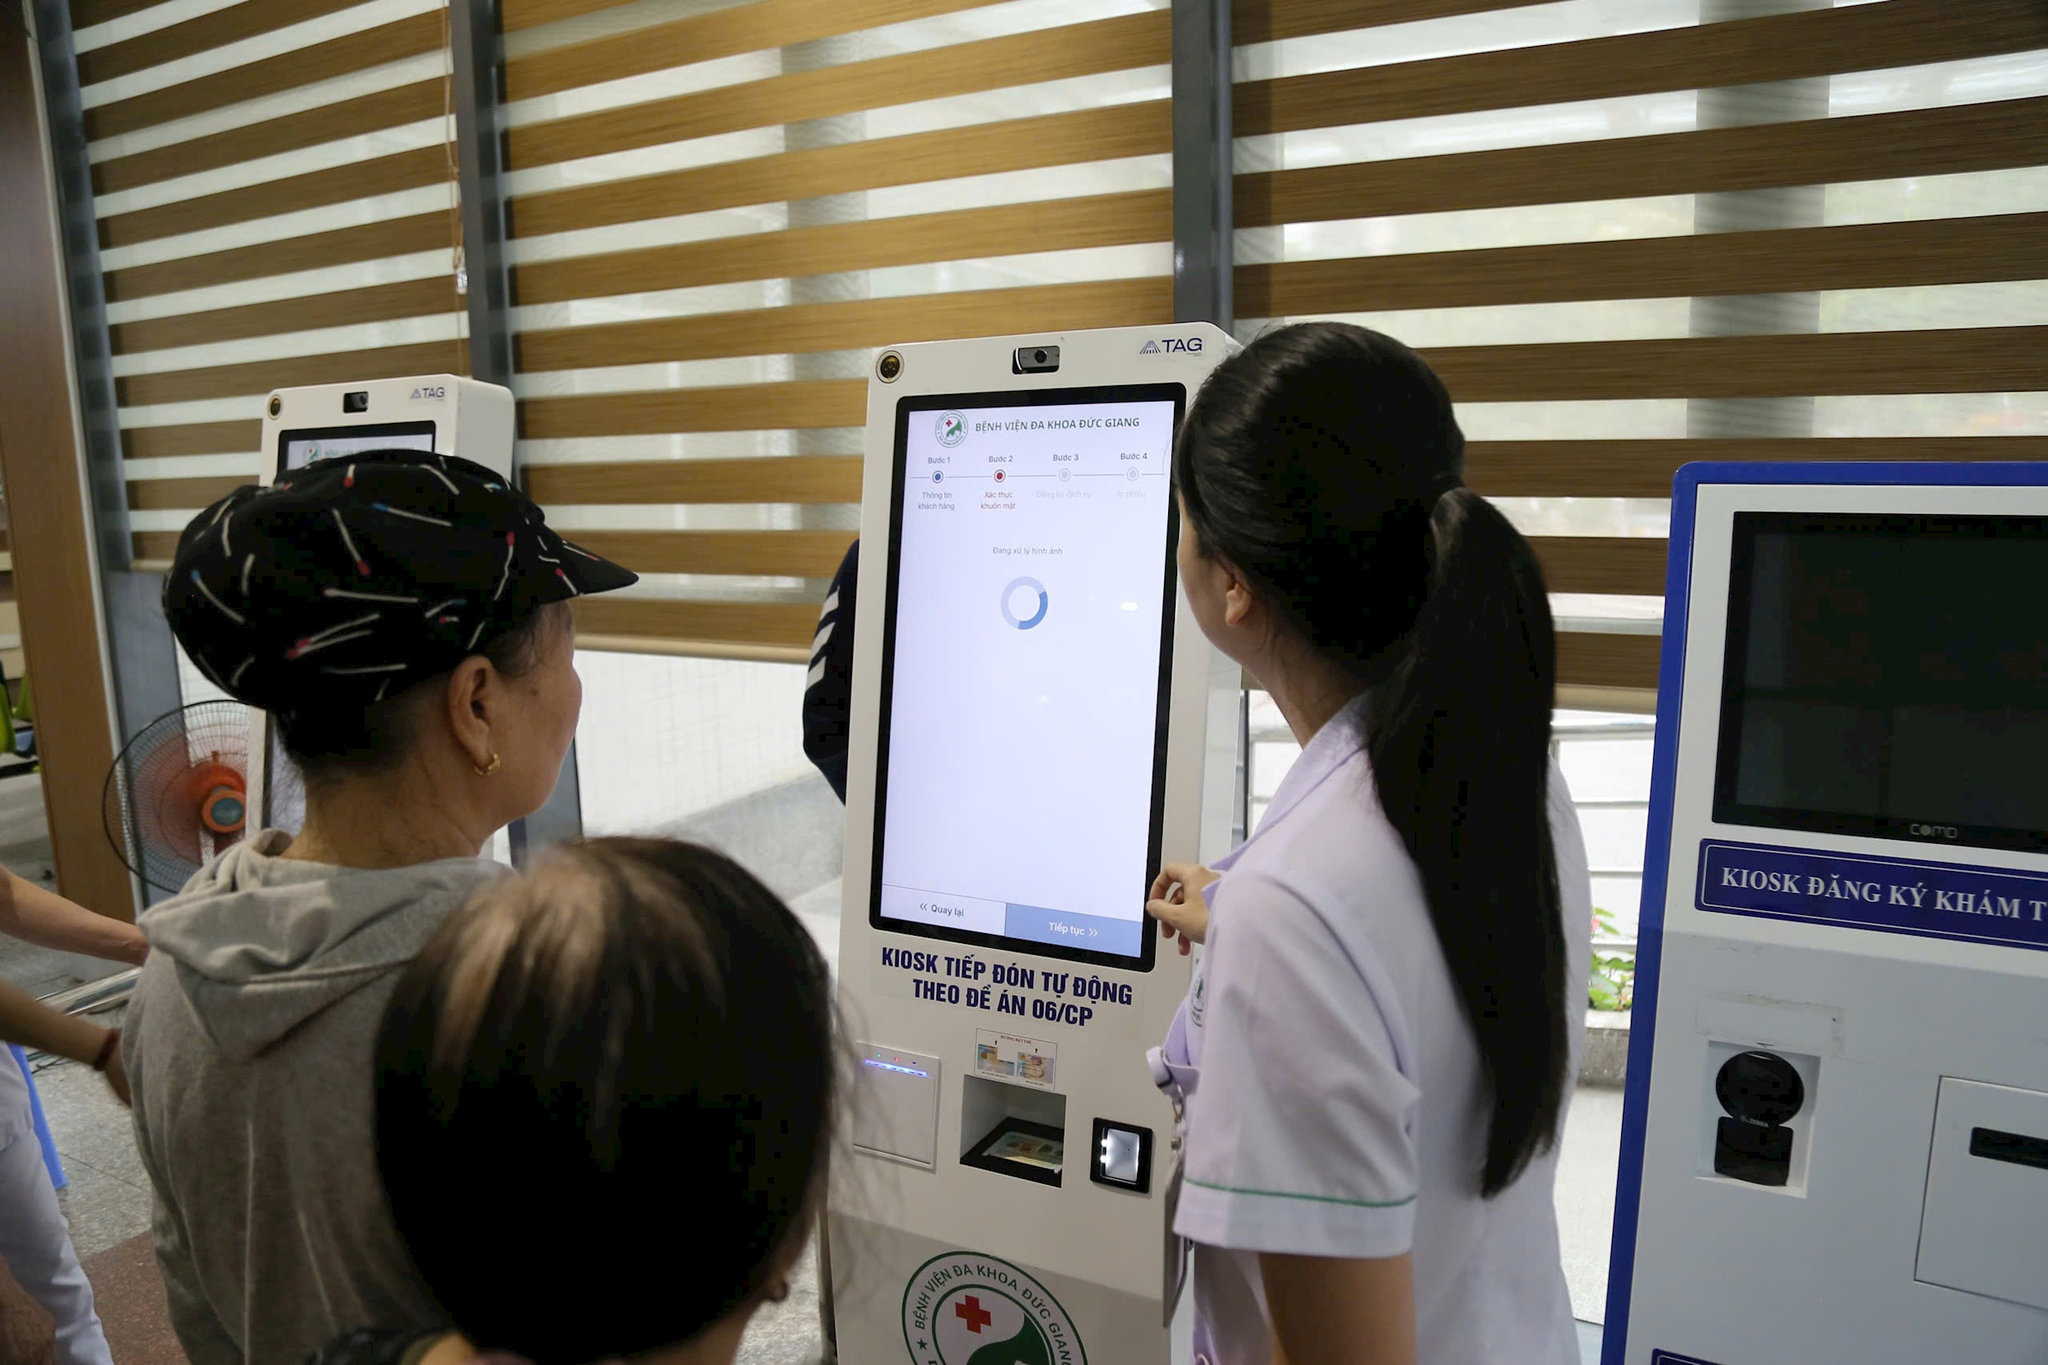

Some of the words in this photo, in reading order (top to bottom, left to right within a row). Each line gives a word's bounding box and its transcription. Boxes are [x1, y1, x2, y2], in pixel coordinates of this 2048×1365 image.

[1162, 338, 1202, 352] TAG
[422, 386, 445, 398] TAG
[976, 421, 1001, 434] BỆNH
[1005, 419, 1027, 433] VIỆN
[1031, 420, 1044, 430] ĐA
[1048, 419, 1076, 430] KHOA
[1079, 416, 1102, 428] ĐỨC
[1105, 417, 1140, 428] GIANG
[1009, 455, 1014, 463] 2
[1074, 453, 1079, 461] 3
[1142, 452, 1148, 460] 4
[1721, 867, 1801, 894] KIOSK
[1807, 873, 1881, 903] ĐĂNG
[1888, 882, 1928, 908] KÝ
[1934, 889, 2021, 919] KHÁM
[931, 904, 952, 916] Quay
[955, 907, 965, 917] lại
[1049, 921, 1068, 934] Tiếp
[1069, 925, 1085, 937] tục
[882, 947, 938, 974] KIOSK
[945, 954, 986, 980] TIẾP
[992, 963, 1034, 989] ĐÓN
[1041, 971, 1069, 998] TỰ
[1073, 975, 1132, 1005] ĐỘNG
[913, 979, 959, 1004] THEO
[966, 984, 991, 1010] ĐỀ
[997, 991, 1025, 1016] ÁN
[1032, 999, 1093, 1026] 06/CP
[914, 1292, 931, 1330] BỆNH
[925, 1268, 952, 1293] VIỆN
[953, 1264, 973, 1277] ĐA
[976, 1264, 1018, 1291] KHOA
[1021, 1288, 1051, 1319] ĐỨC
